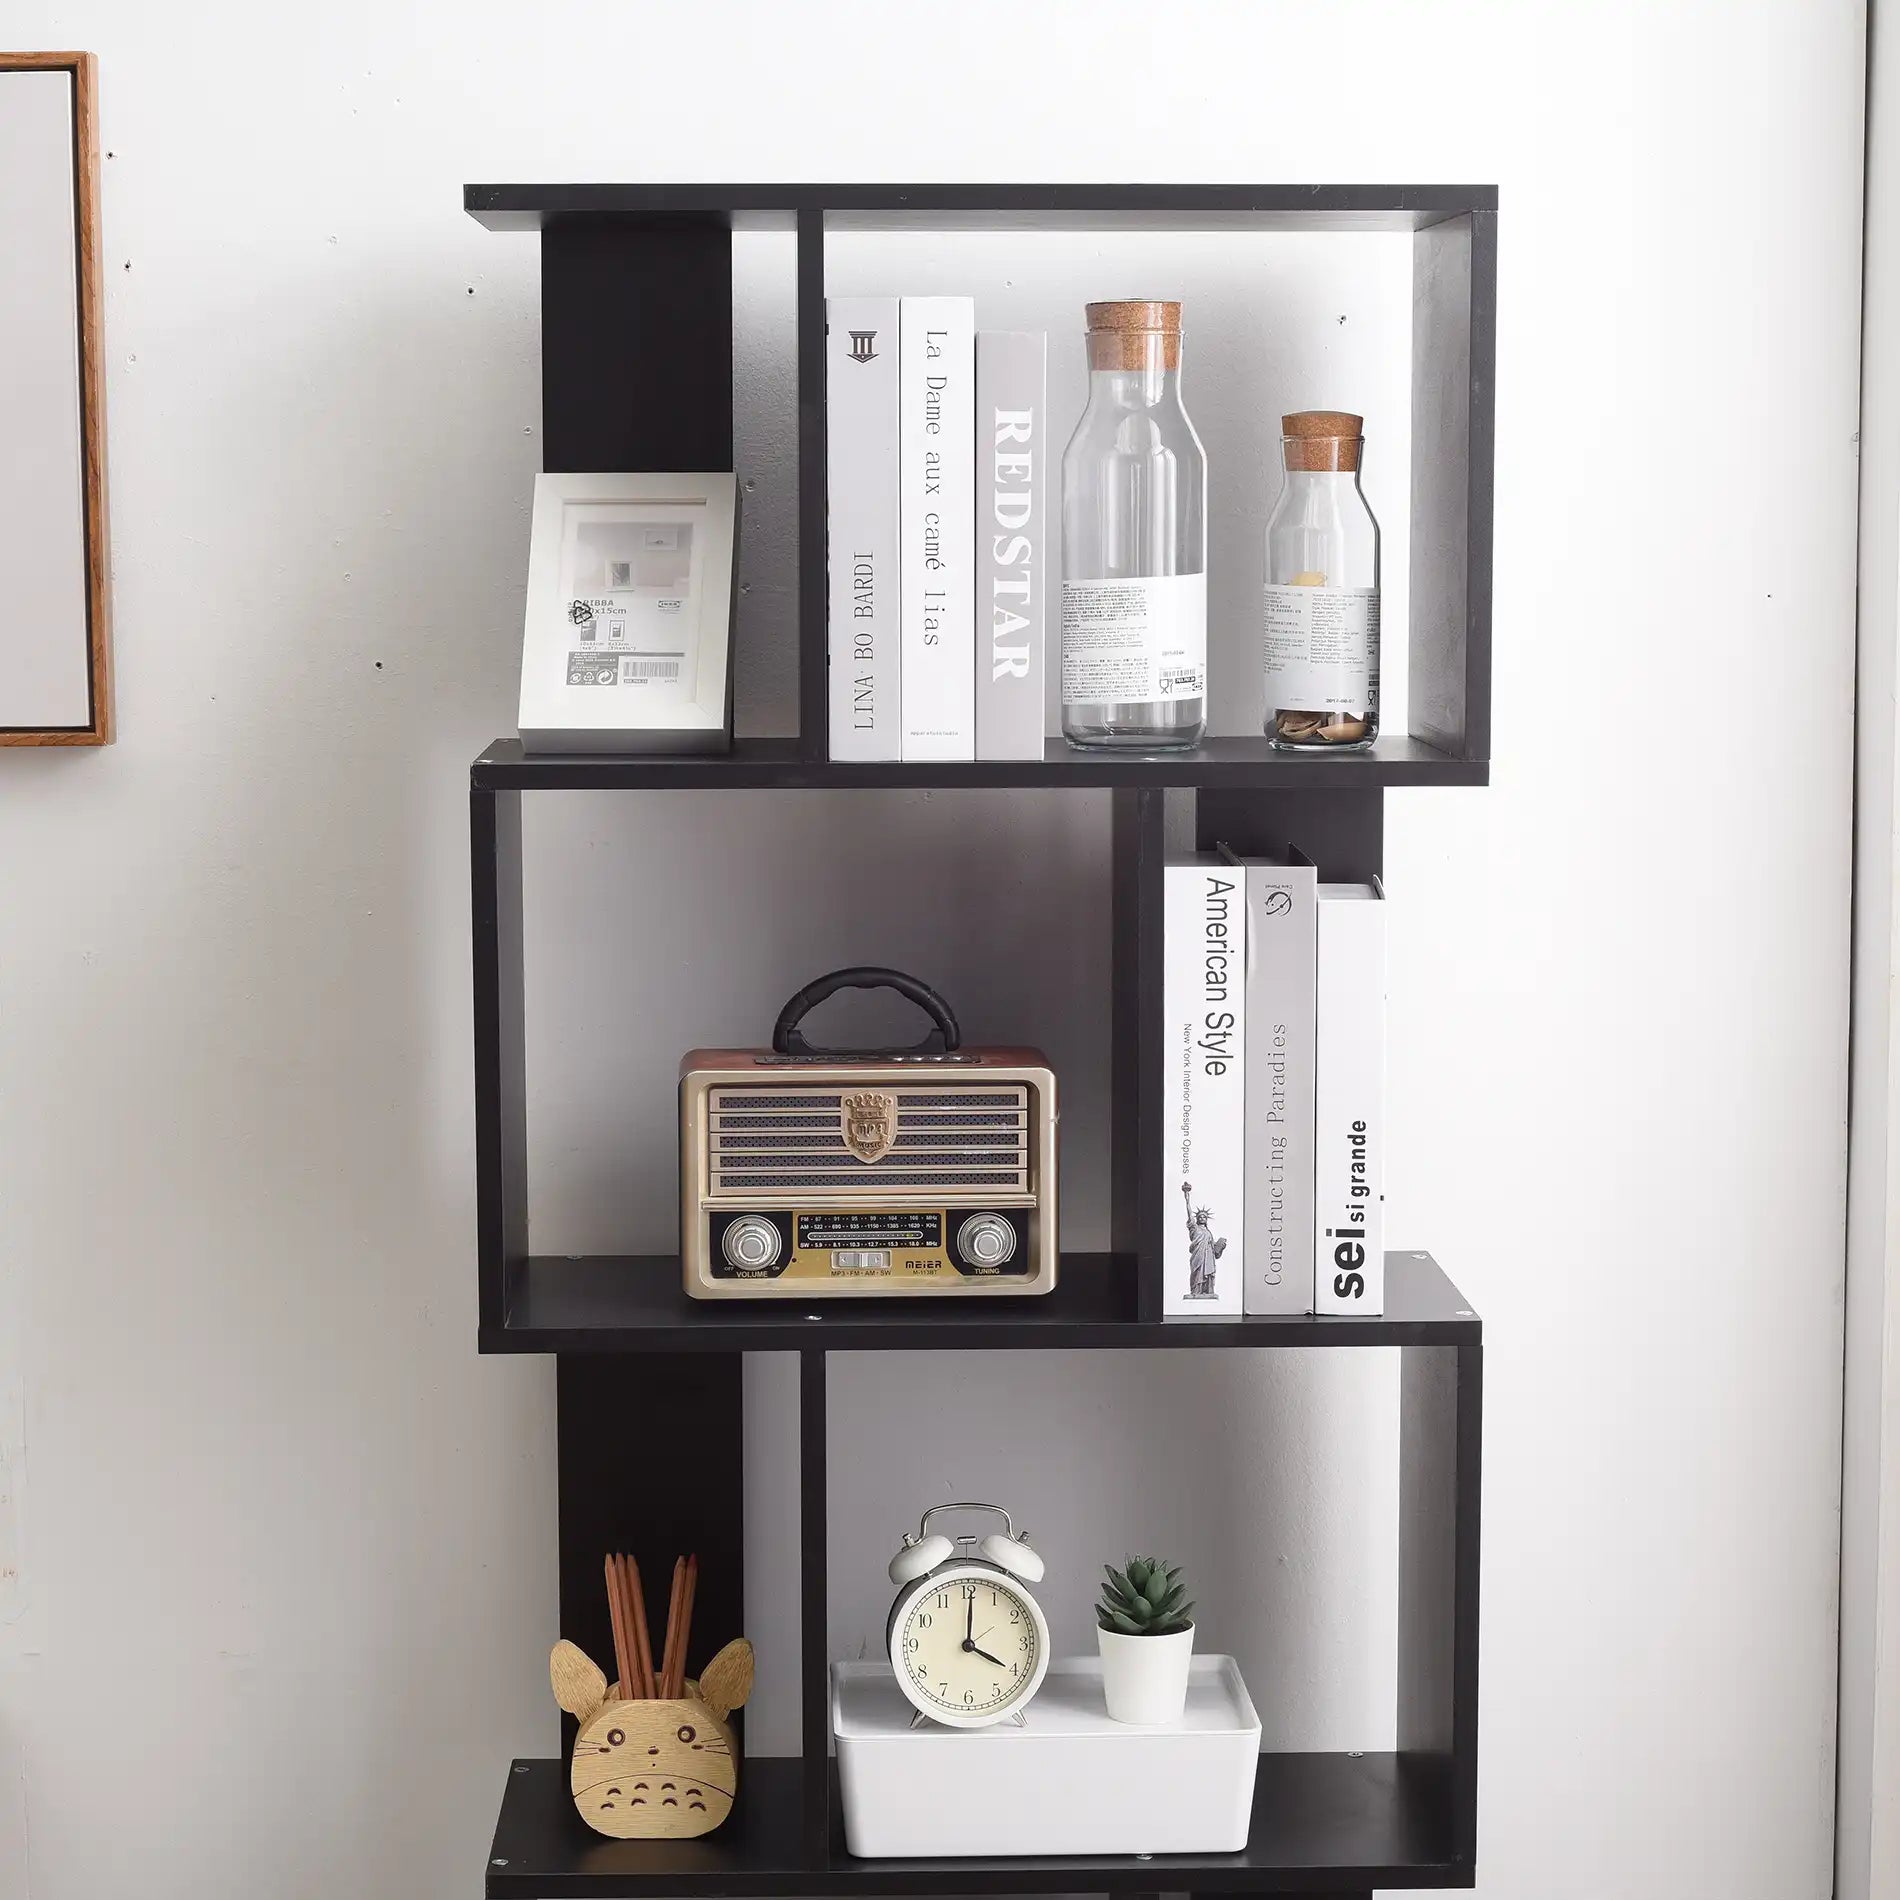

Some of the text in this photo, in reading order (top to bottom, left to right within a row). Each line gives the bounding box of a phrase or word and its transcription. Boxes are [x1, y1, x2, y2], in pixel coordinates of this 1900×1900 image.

[923, 330, 948, 646] La Dame aux camé lias
[992, 406, 1033, 682] REDSTAR
[853, 551, 874, 730] LINA BO BARDI
[1197, 877, 1236, 1077] American Style
[1180, 1023, 1192, 1175] New York Interior Design Opuses
[1263, 1024, 1288, 1287] Constructing Paradies
[1325, 1120, 1370, 1300] sei si grande
[849, 1268, 861, 1276] FM
[974, 1267, 1000, 1275] TUNING
[961, 1584, 977, 1600] 12
[991, 1591, 997, 1607] 1
[936, 1594, 949, 1609] 11
[919, 1613, 933, 1629] 10
[1009, 1609, 1020, 1625] 2
[908, 1637, 919, 1653] 9
[1018, 1635, 1029, 1652] 3
[917, 1663, 928, 1680] 8
[1008, 1661, 1020, 1677] 4
[939, 1682, 948, 1697] 7
[963, 1689, 974, 1705] 6
[991, 1682, 1001, 1698] 5
